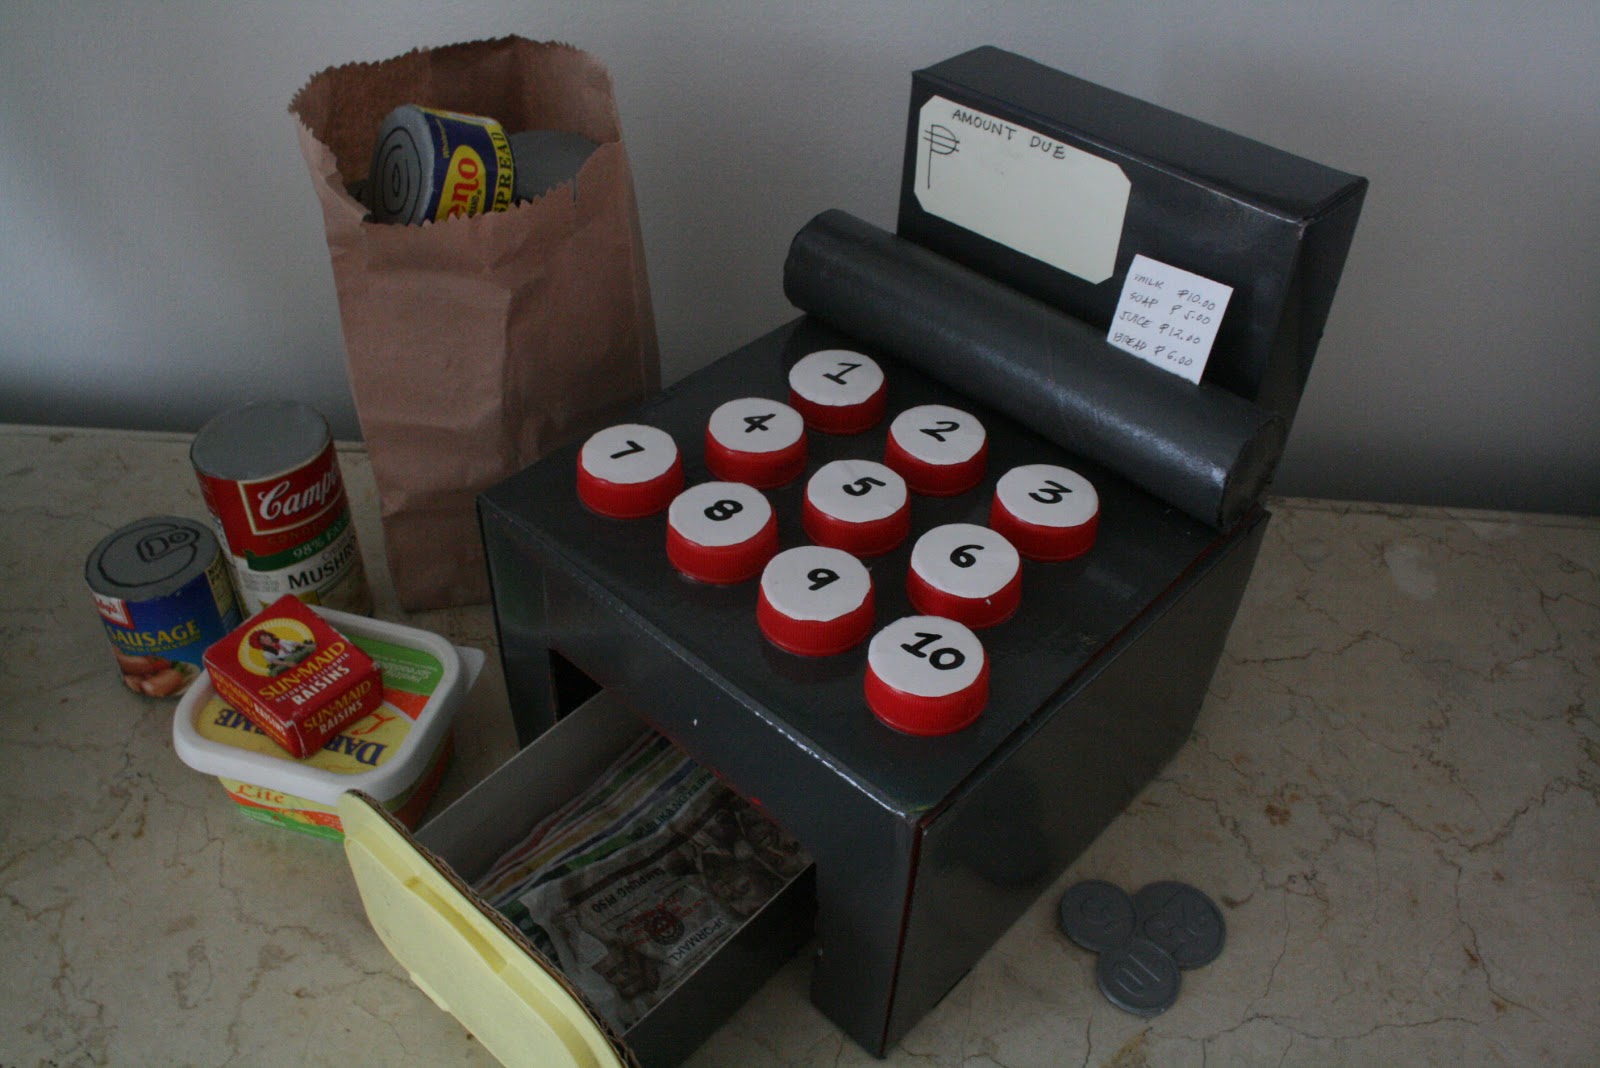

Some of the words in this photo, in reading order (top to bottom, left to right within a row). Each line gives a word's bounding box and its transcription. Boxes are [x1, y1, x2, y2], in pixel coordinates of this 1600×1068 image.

[952, 109, 1017, 141] AMOUNT
[1029, 135, 1066, 160] DUE
[1133, 273, 1166, 290] MILK
[1128, 292, 1159, 309] SOAP
[1119, 310, 1152, 329] JUICE
[1113, 332, 1148, 351] BREAD
[822, 361, 863, 385] 1
[742, 411, 777, 433] 4
[919, 420, 961, 442] 2
[609, 440, 646, 460] 7
[842, 476, 887, 497] 5
[1028, 479, 1074, 505] 3
[703, 499, 744, 522] 8
[292, 538, 325, 558] 98%
[949, 543, 985, 568] 6
[806, 567, 841, 591] 9
[109, 619, 200, 648] SAUSAGE
[900, 631, 966, 671] 10
[290, 665, 351, 706] RAISINS
[319, 700, 363, 736] RAISINS
[235, 783, 286, 804] Lite
